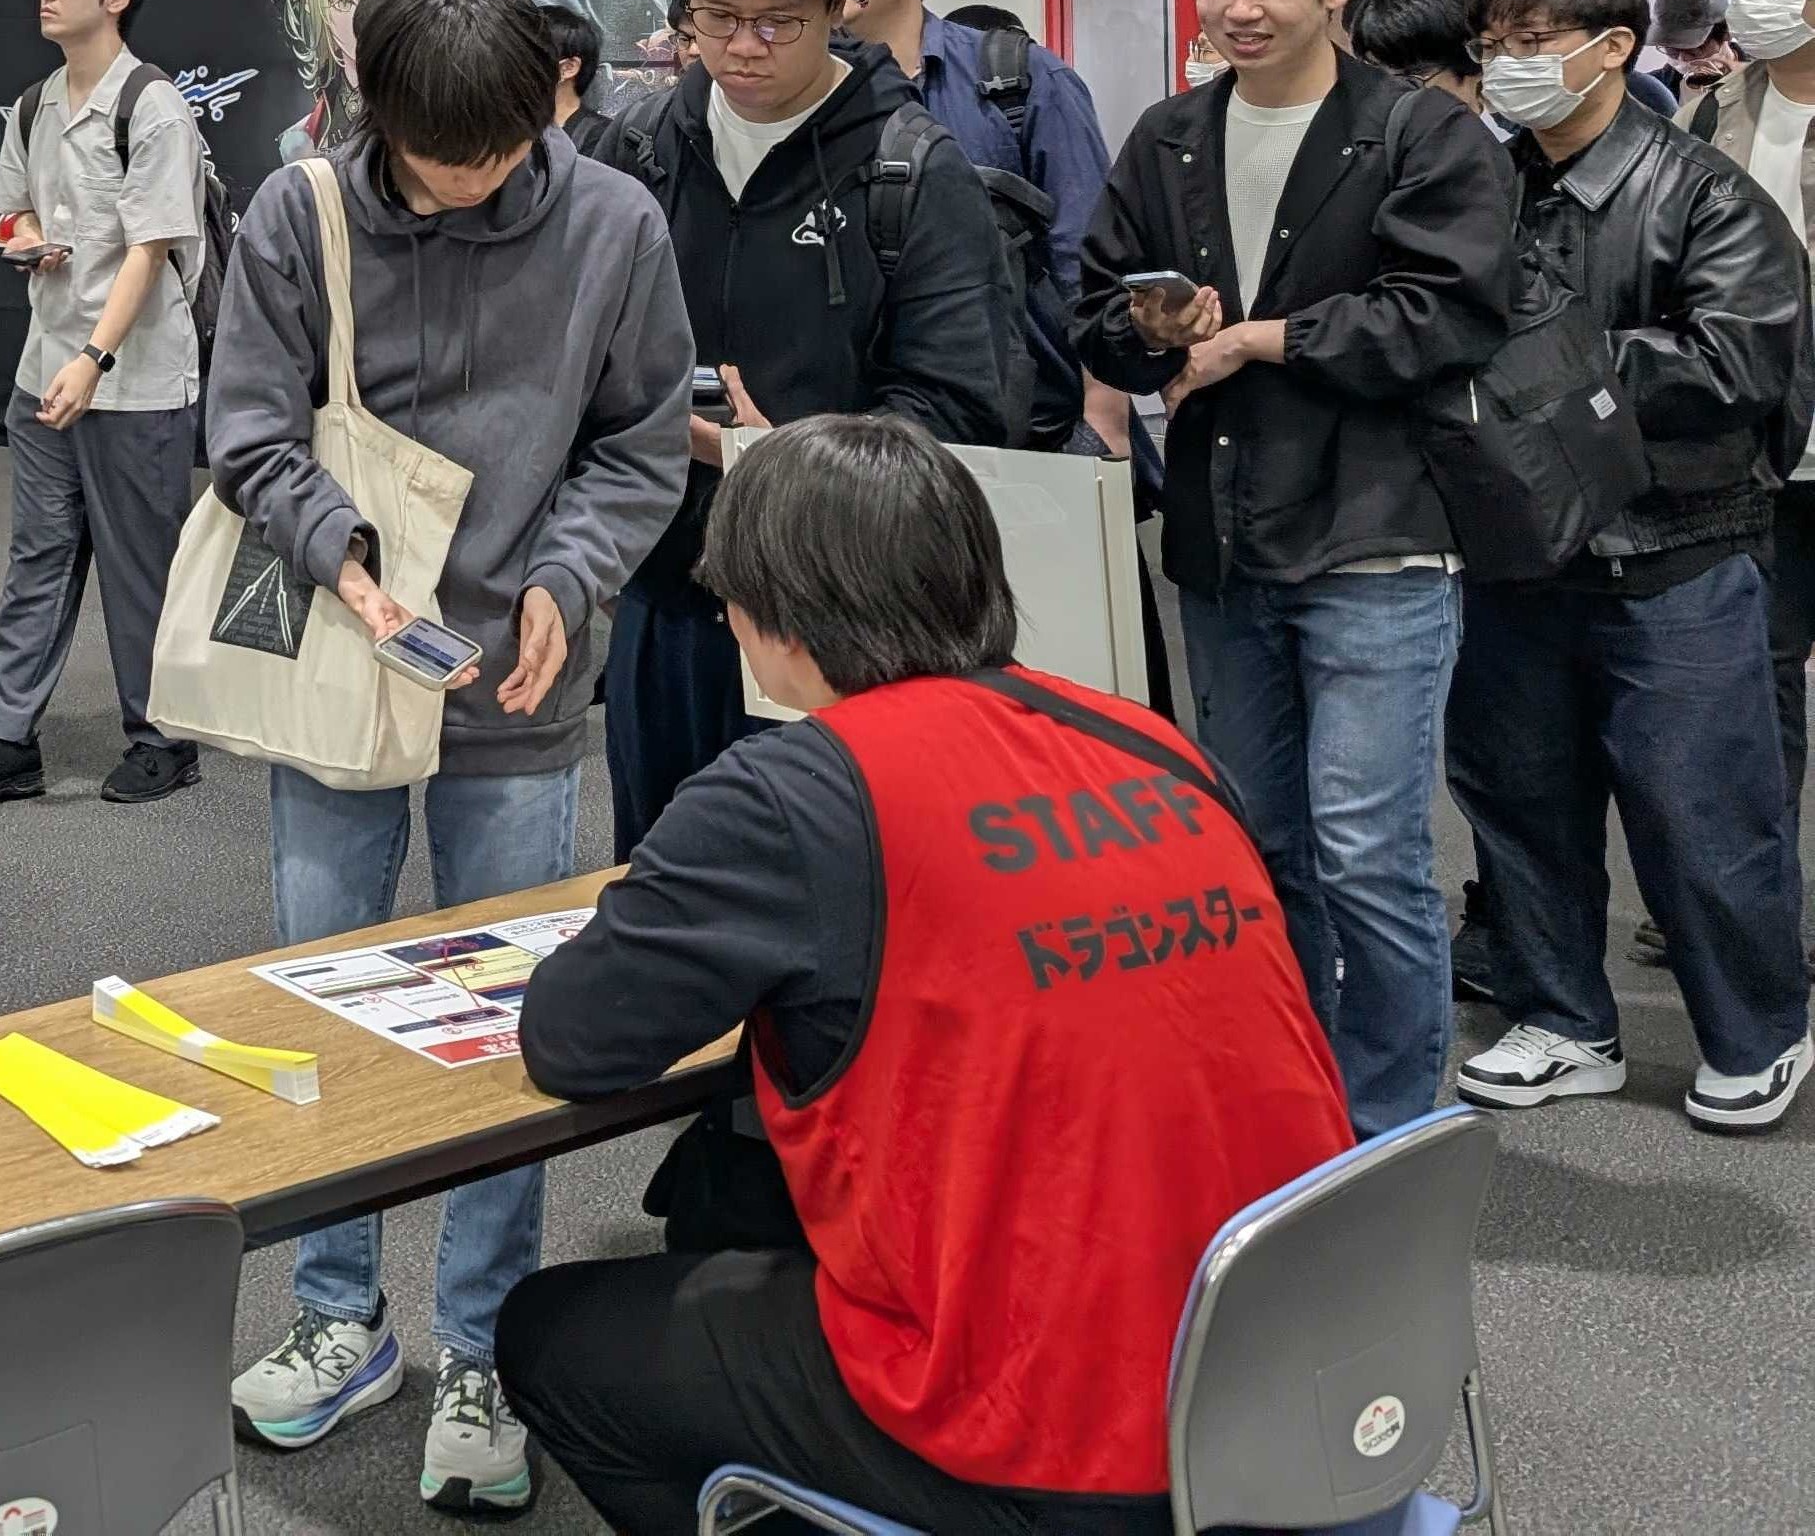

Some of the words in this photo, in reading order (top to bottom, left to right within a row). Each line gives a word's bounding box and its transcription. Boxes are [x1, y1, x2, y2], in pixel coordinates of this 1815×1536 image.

[968, 774, 1204, 875] STAFF
[1016, 885, 1263, 990] ドラゴンスター
